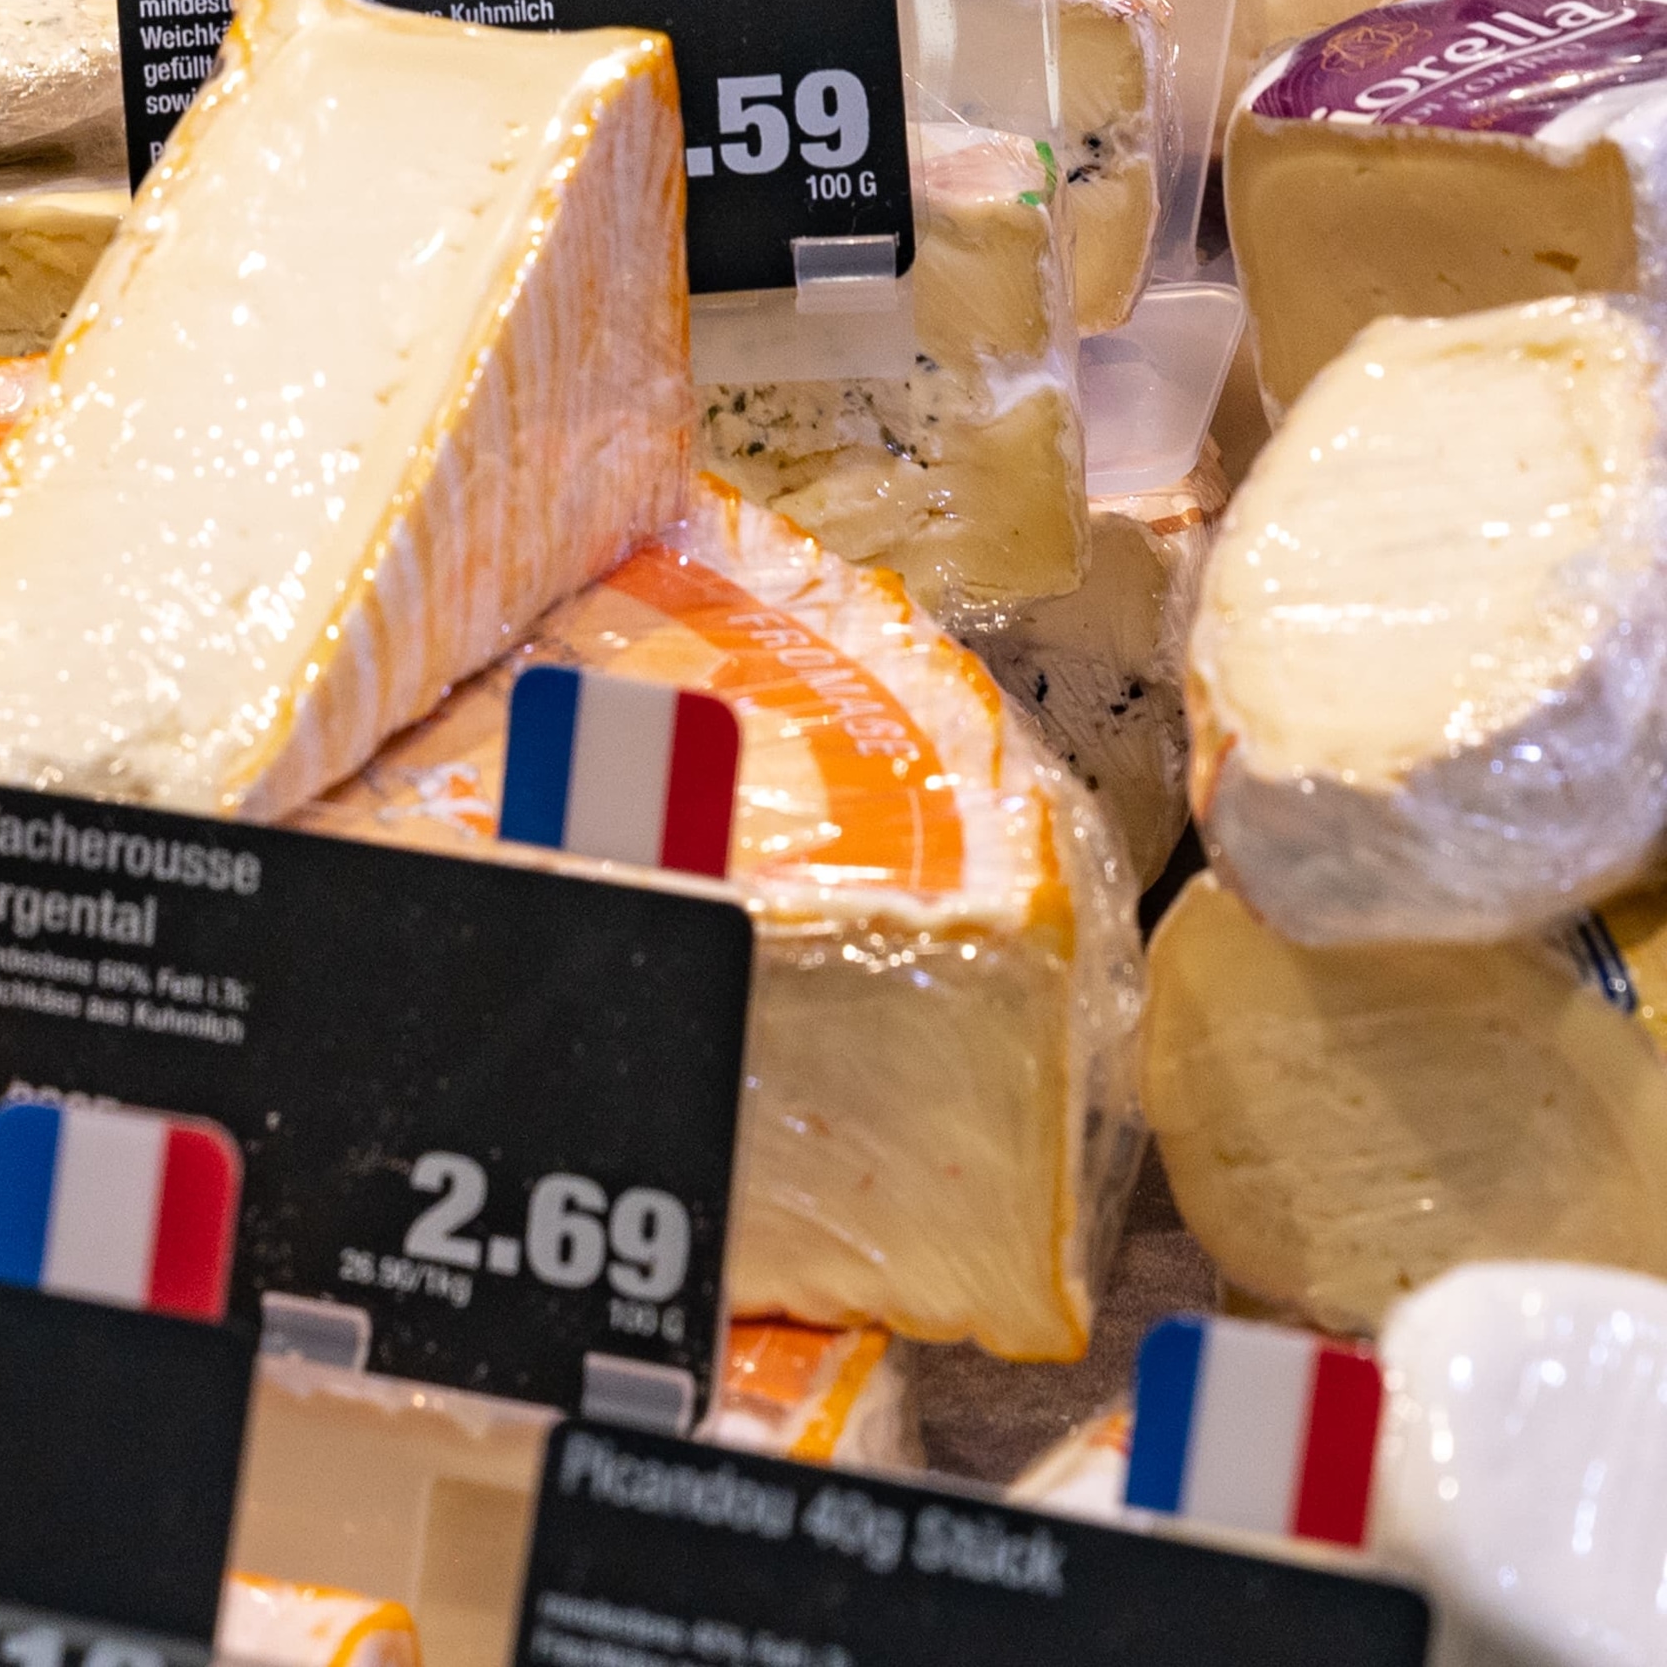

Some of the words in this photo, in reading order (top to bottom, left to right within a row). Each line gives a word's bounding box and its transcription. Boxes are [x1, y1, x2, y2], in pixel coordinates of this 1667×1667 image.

[1310, 0, 1618, 125] iorella
[685, 67, 872, 178] .59
[805, 172, 853, 201] 100
[858, 170, 878, 197] G
[403, 1151, 690, 1302] 2.69
